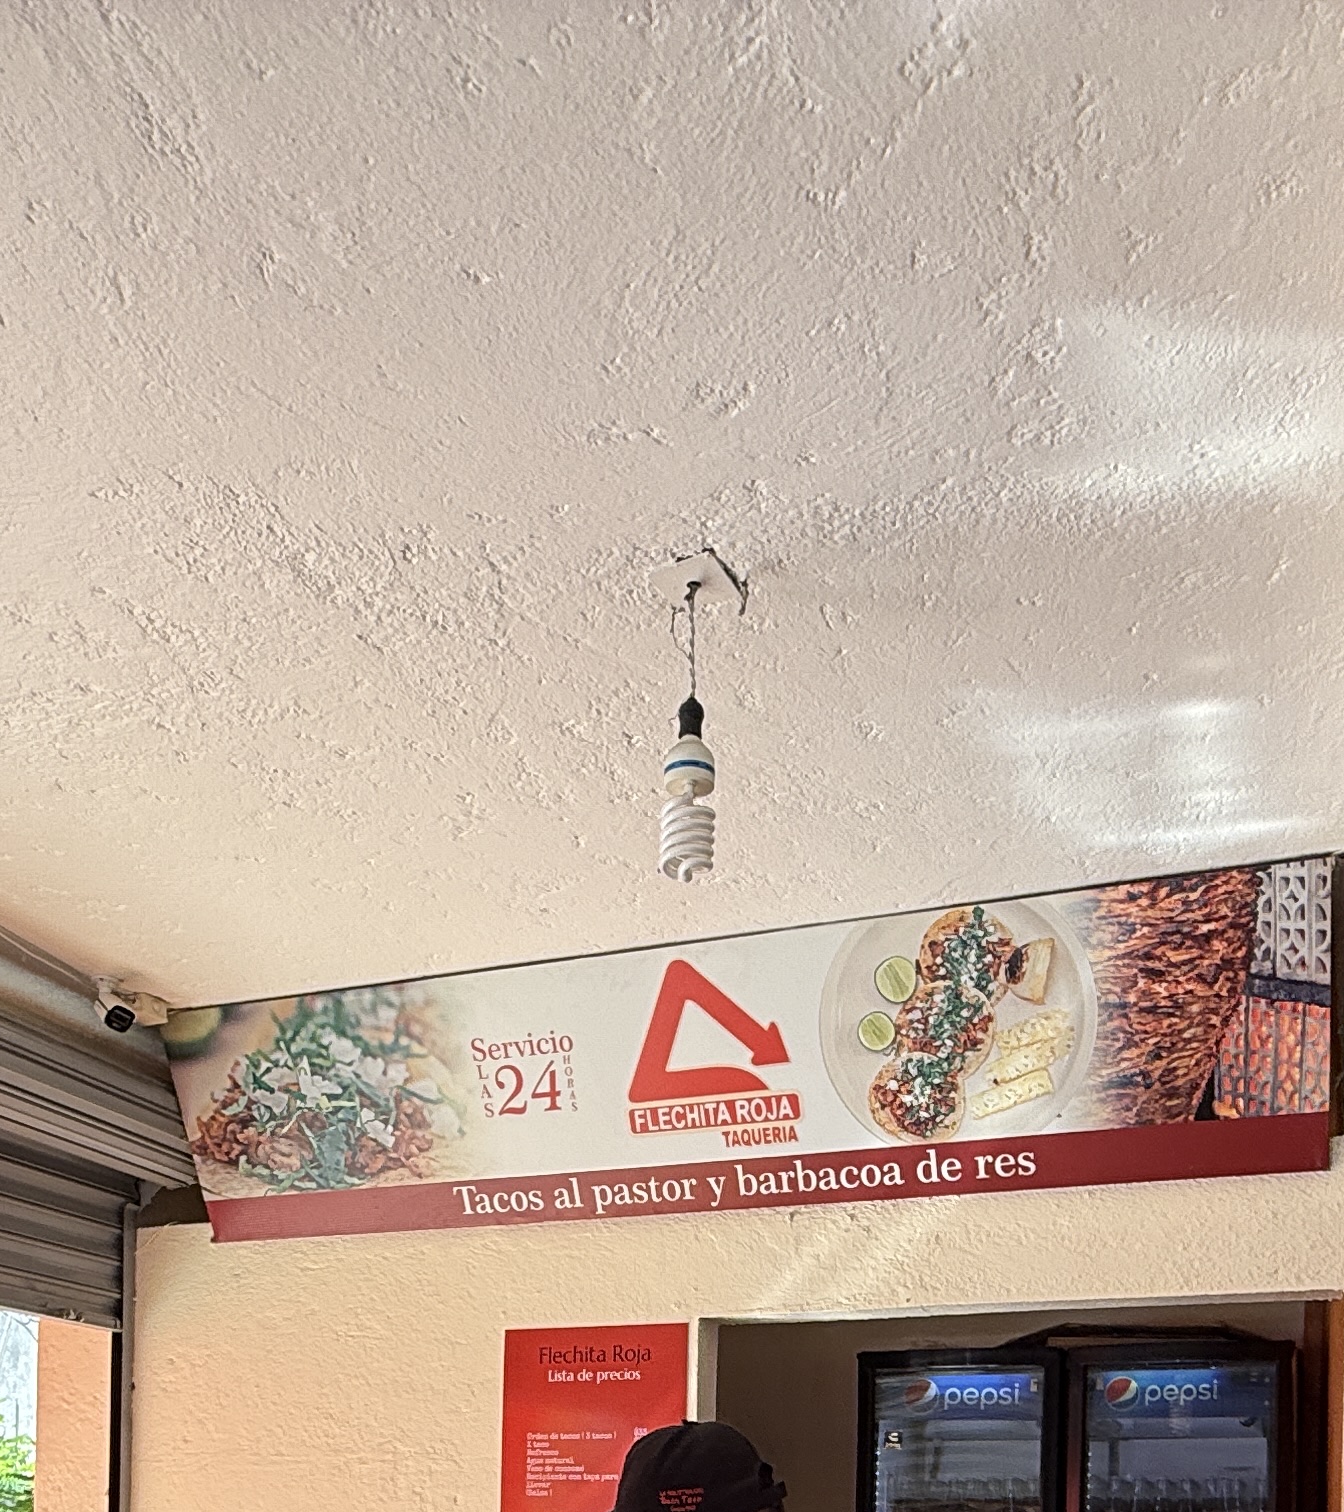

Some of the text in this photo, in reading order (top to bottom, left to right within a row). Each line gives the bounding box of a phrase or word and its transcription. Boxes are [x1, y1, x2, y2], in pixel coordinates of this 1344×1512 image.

[470, 1030, 573, 1062] Servicio
[476, 1064, 495, 1118] LAS
[495, 1060, 562, 1116] 24
[563, 1055, 578, 1112] HORAS
[633, 1095, 795, 1133] FLECHITA ROJA
[722, 1125, 799, 1148] TAQUERIA
[453, 1149, 1037, 1216] Tacos al pastor y barbacoa de res
[539, 1344, 651, 1366] Flechita Roja
[548, 1368, 641, 1384] Lista de precios
[944, 1383, 1020, 1410] pepsi
[1145, 1379, 1218, 1406] pepsi
